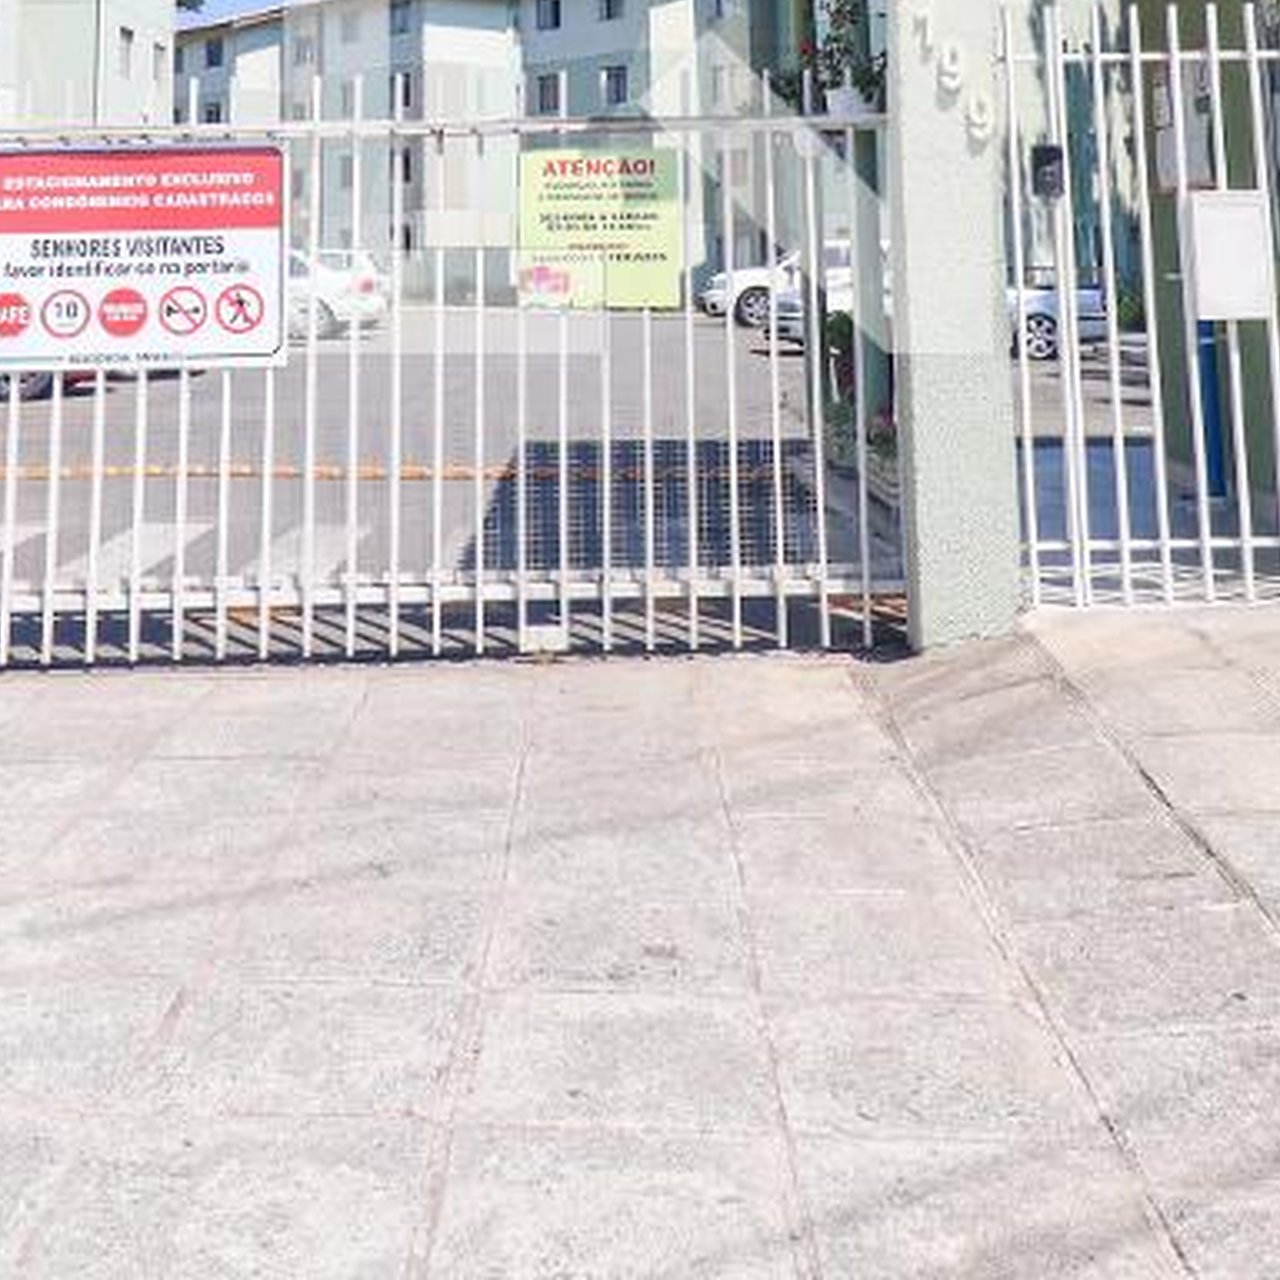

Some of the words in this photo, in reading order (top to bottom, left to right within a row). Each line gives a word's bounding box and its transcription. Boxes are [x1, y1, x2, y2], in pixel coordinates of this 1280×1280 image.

[31, 238, 121, 259] SENHORES
[125, 235, 225, 257] VISITANTES
[159, 262, 181, 275] na
